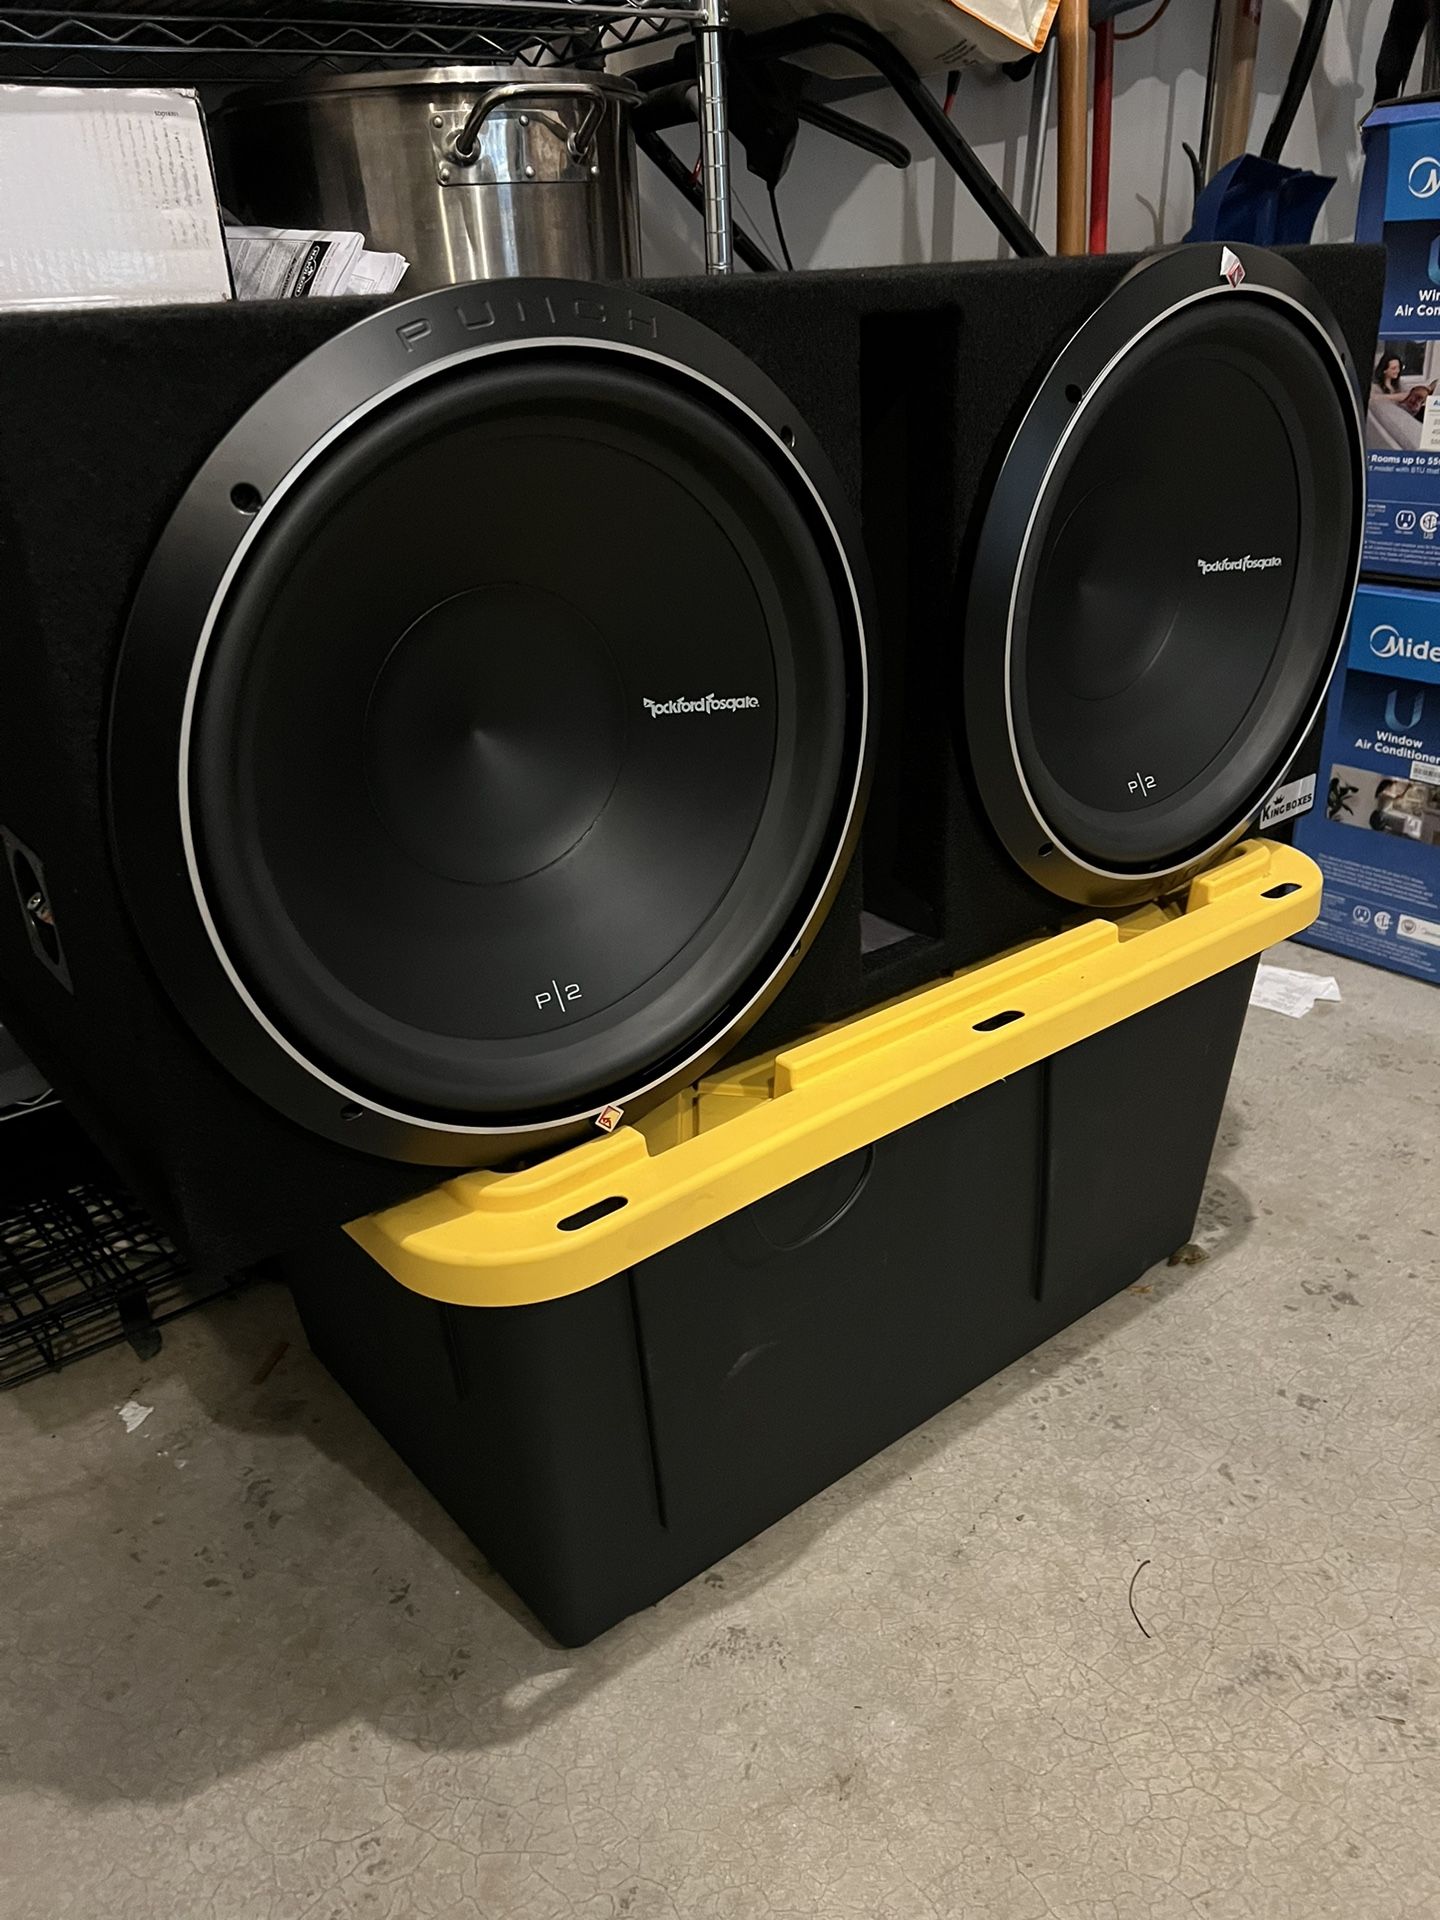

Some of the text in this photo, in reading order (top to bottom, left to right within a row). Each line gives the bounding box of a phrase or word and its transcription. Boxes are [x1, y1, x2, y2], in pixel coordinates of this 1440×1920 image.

[1395, 304, 1414, 316] Air
[396, 297, 658, 352] PUNCH
[1371, 454, 1400, 464] Rooms
[1402, 457, 1414, 466] up
[1416, 456, 1425, 465] to
[1376, 730, 1423, 749] Window
[1354, 738, 1440, 764] Air Conditioner
